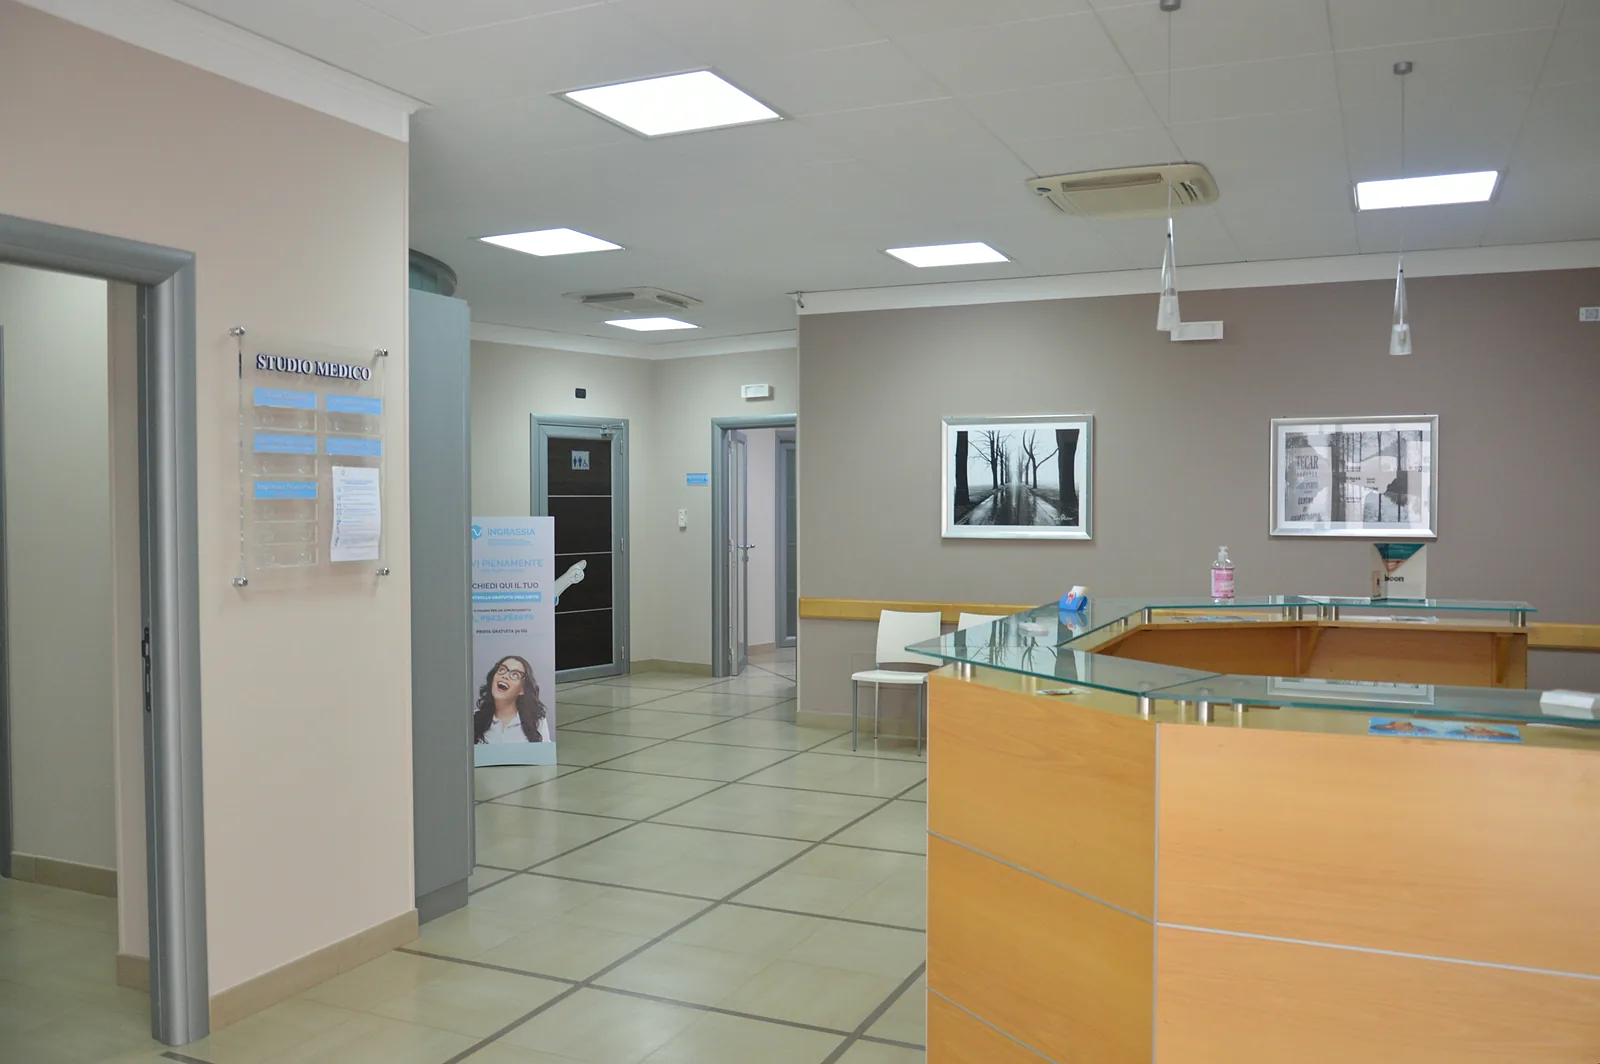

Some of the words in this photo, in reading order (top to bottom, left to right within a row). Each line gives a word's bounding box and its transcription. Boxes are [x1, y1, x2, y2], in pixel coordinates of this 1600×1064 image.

[256, 354, 313, 375] STUDIO
[315, 361, 372, 381] MEDICO
[487, 528, 536, 536] INGRASSIA
[482, 559, 543, 568] PIENAMENTE
